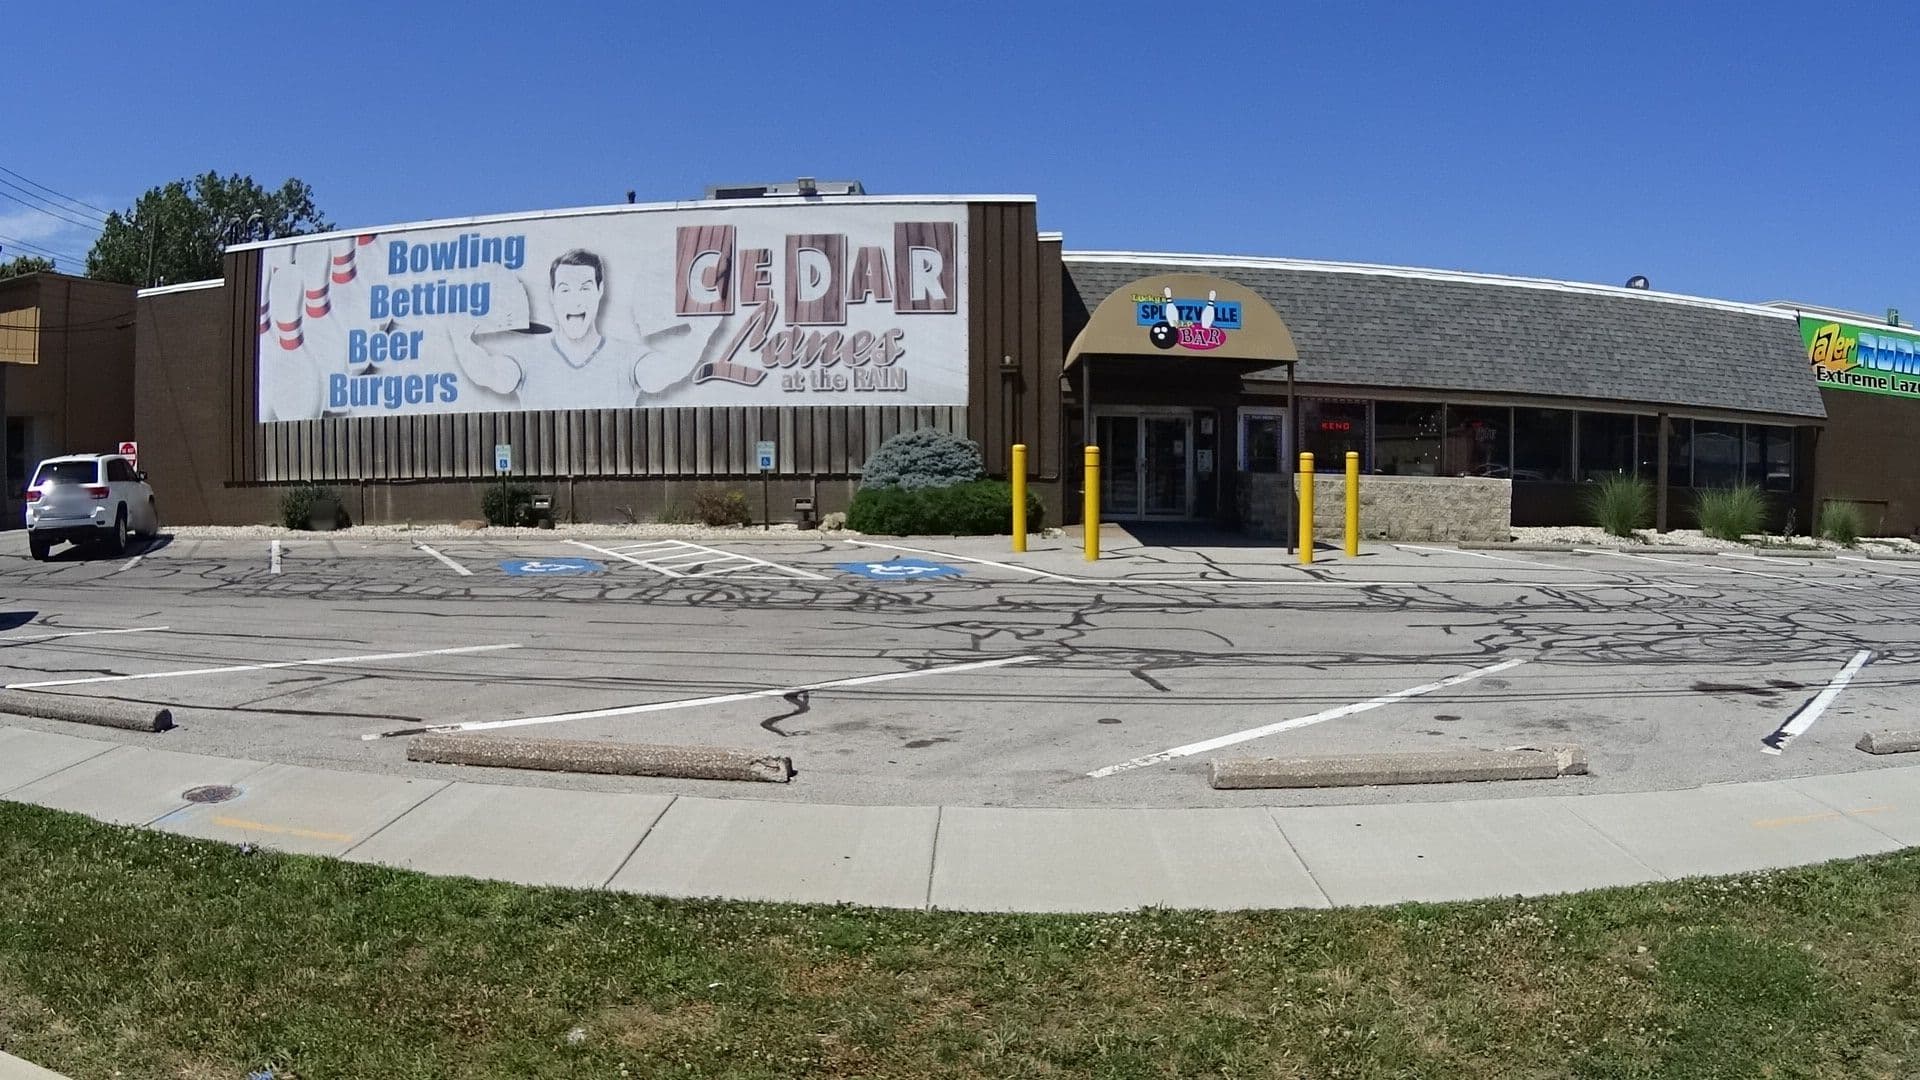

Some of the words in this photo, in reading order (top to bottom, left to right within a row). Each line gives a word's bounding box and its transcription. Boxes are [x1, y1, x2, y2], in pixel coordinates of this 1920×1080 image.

[388, 233, 525, 275] Bowling
[677, 227, 956, 317] CEDAR
[370, 279, 490, 319] Betting
[349, 328, 424, 364] Beer
[693, 301, 904, 387] Lanes
[1180, 327, 1221, 346] BAR
[329, 373, 457, 409] Burgers
[782, 369, 805, 392] at
[810, 367, 848, 392] the
[853, 367, 907, 392] RAIN
[1816, 365, 1888, 389] Extreme
[1321, 422, 1350, 431] KENO
